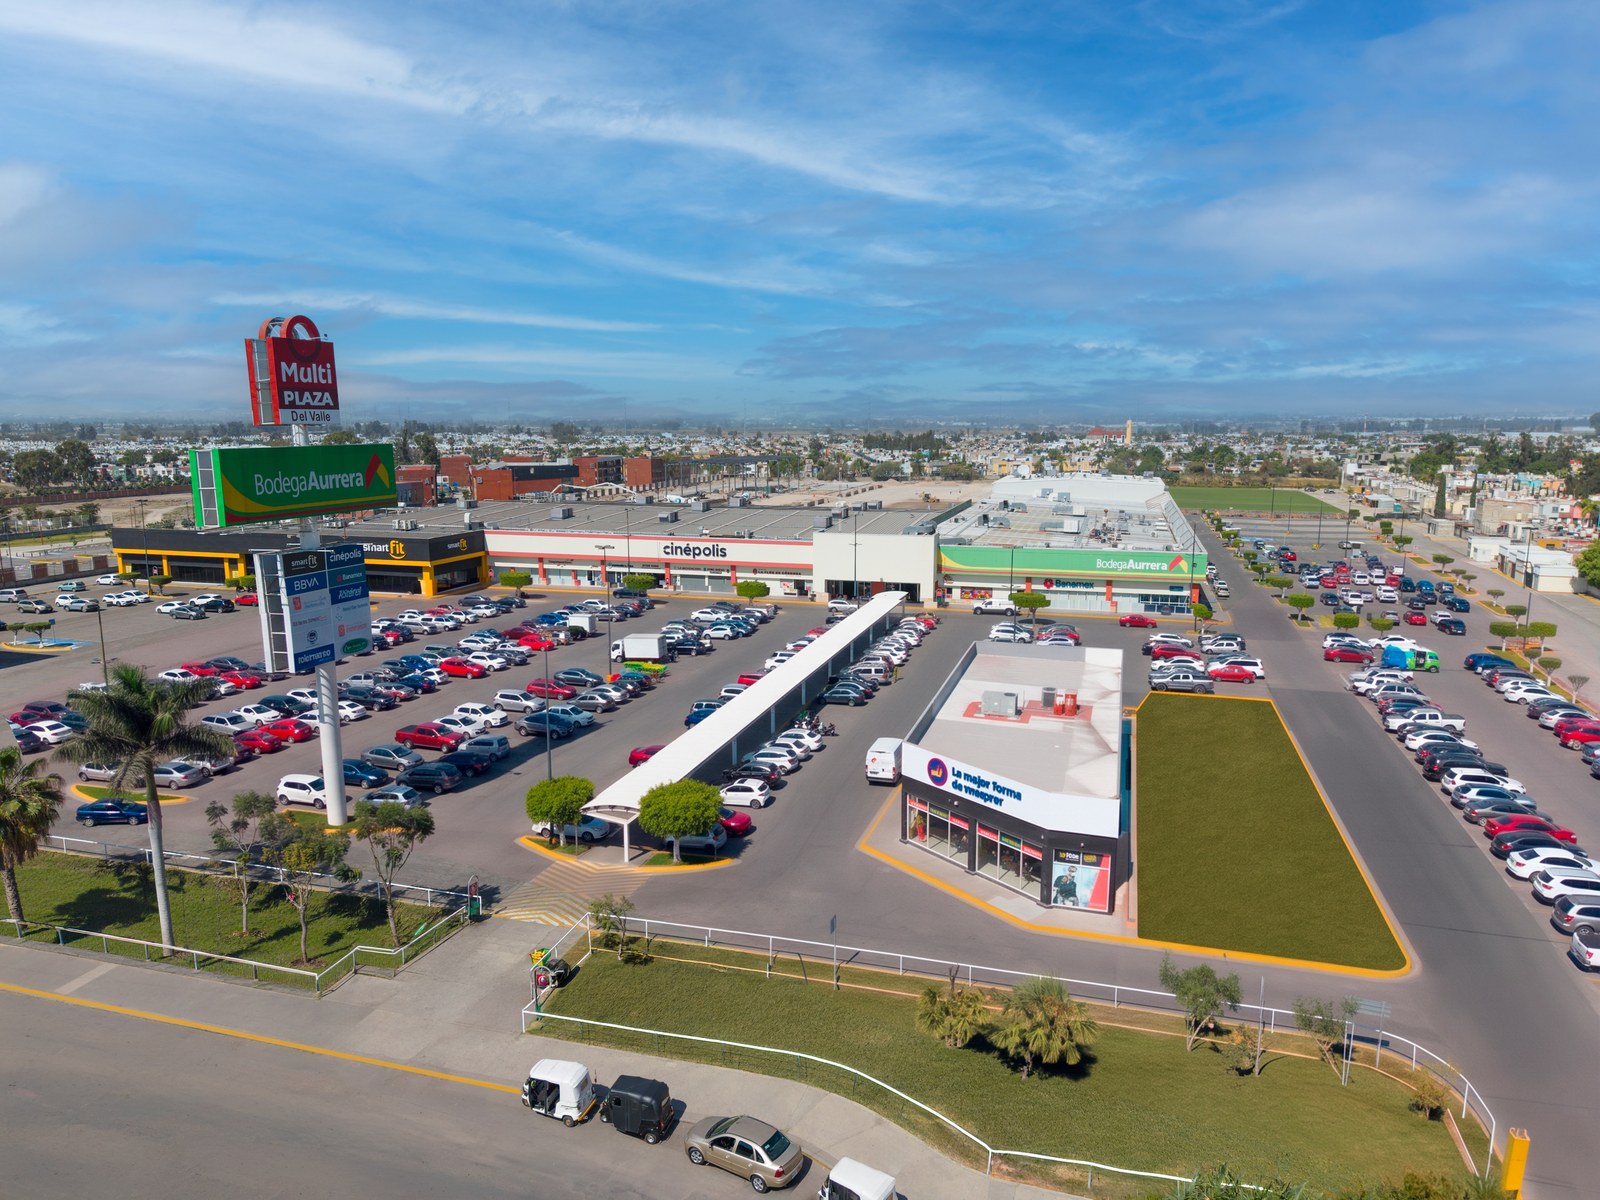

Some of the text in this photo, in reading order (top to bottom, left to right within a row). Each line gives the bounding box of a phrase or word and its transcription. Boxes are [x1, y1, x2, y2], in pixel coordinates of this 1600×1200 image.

[280, 361, 332, 384] Multi
[283, 390, 334, 407] PLAZA
[291, 410, 331, 422] Del Valle
[329, 548, 362, 562] cinépolis
[363, 540, 405, 556] smart fit
[663, 542, 727, 559] cinépolis
[291, 554, 318, 567] smart fit
[294, 577, 319, 591] BBVA
[1055, 580, 1095, 589] Banamex
[951, 767, 962, 779] La
